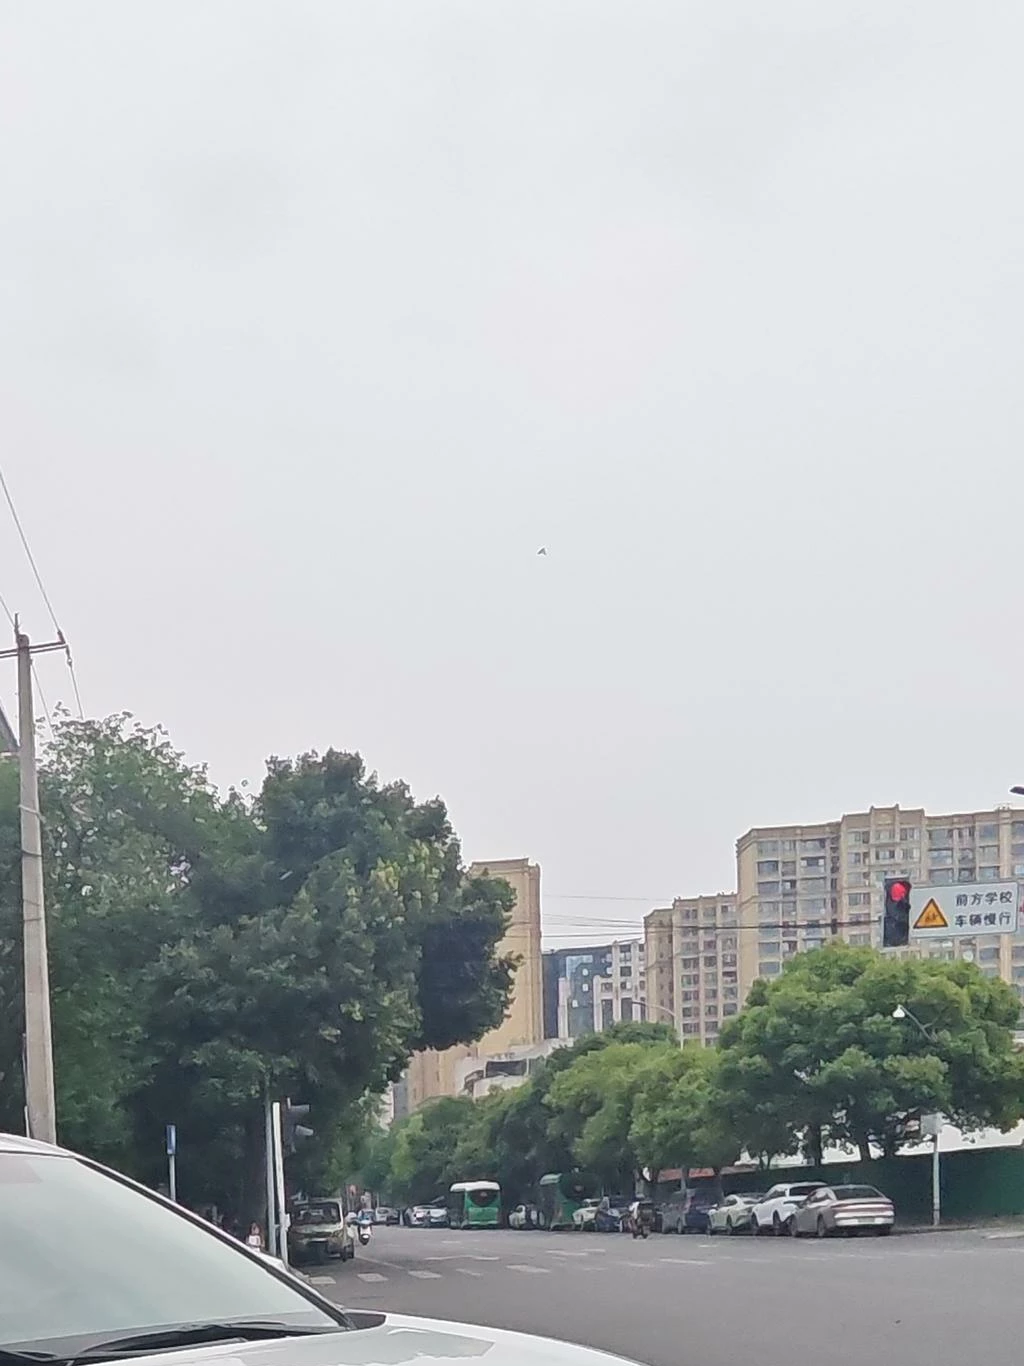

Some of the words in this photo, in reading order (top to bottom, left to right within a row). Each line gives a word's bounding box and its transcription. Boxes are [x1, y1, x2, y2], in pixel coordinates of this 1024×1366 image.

[956, 891, 1012, 906] 前方学校
[955, 912, 1011, 927] 车辆慢行
